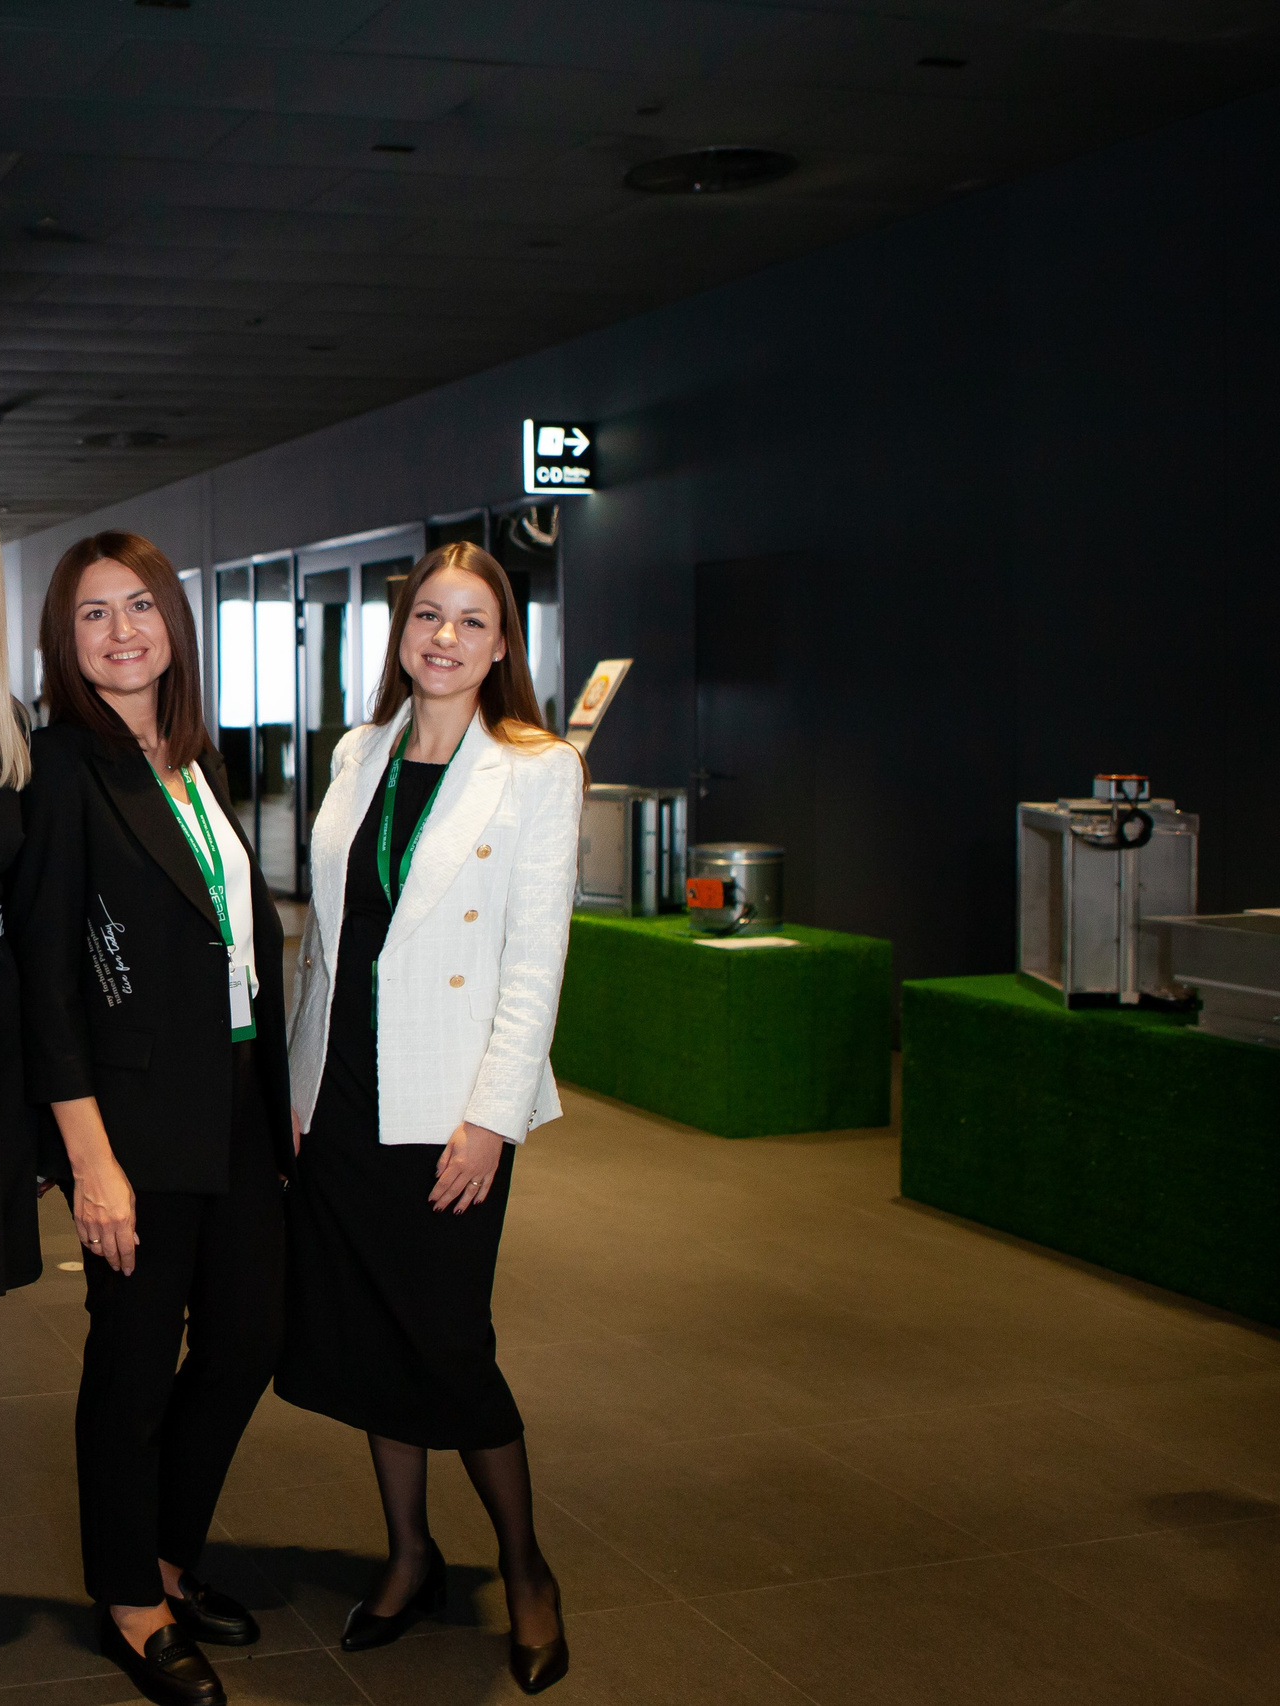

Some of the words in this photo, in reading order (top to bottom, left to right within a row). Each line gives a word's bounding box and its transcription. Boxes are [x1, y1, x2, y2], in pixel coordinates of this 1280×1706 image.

[92, 954, 110, 993] forbidden
[102, 963, 111, 976] me
[107, 977, 123, 1005] named
[228, 980, 243, 989] ЕЗА
[106, 995, 115, 1008] my
